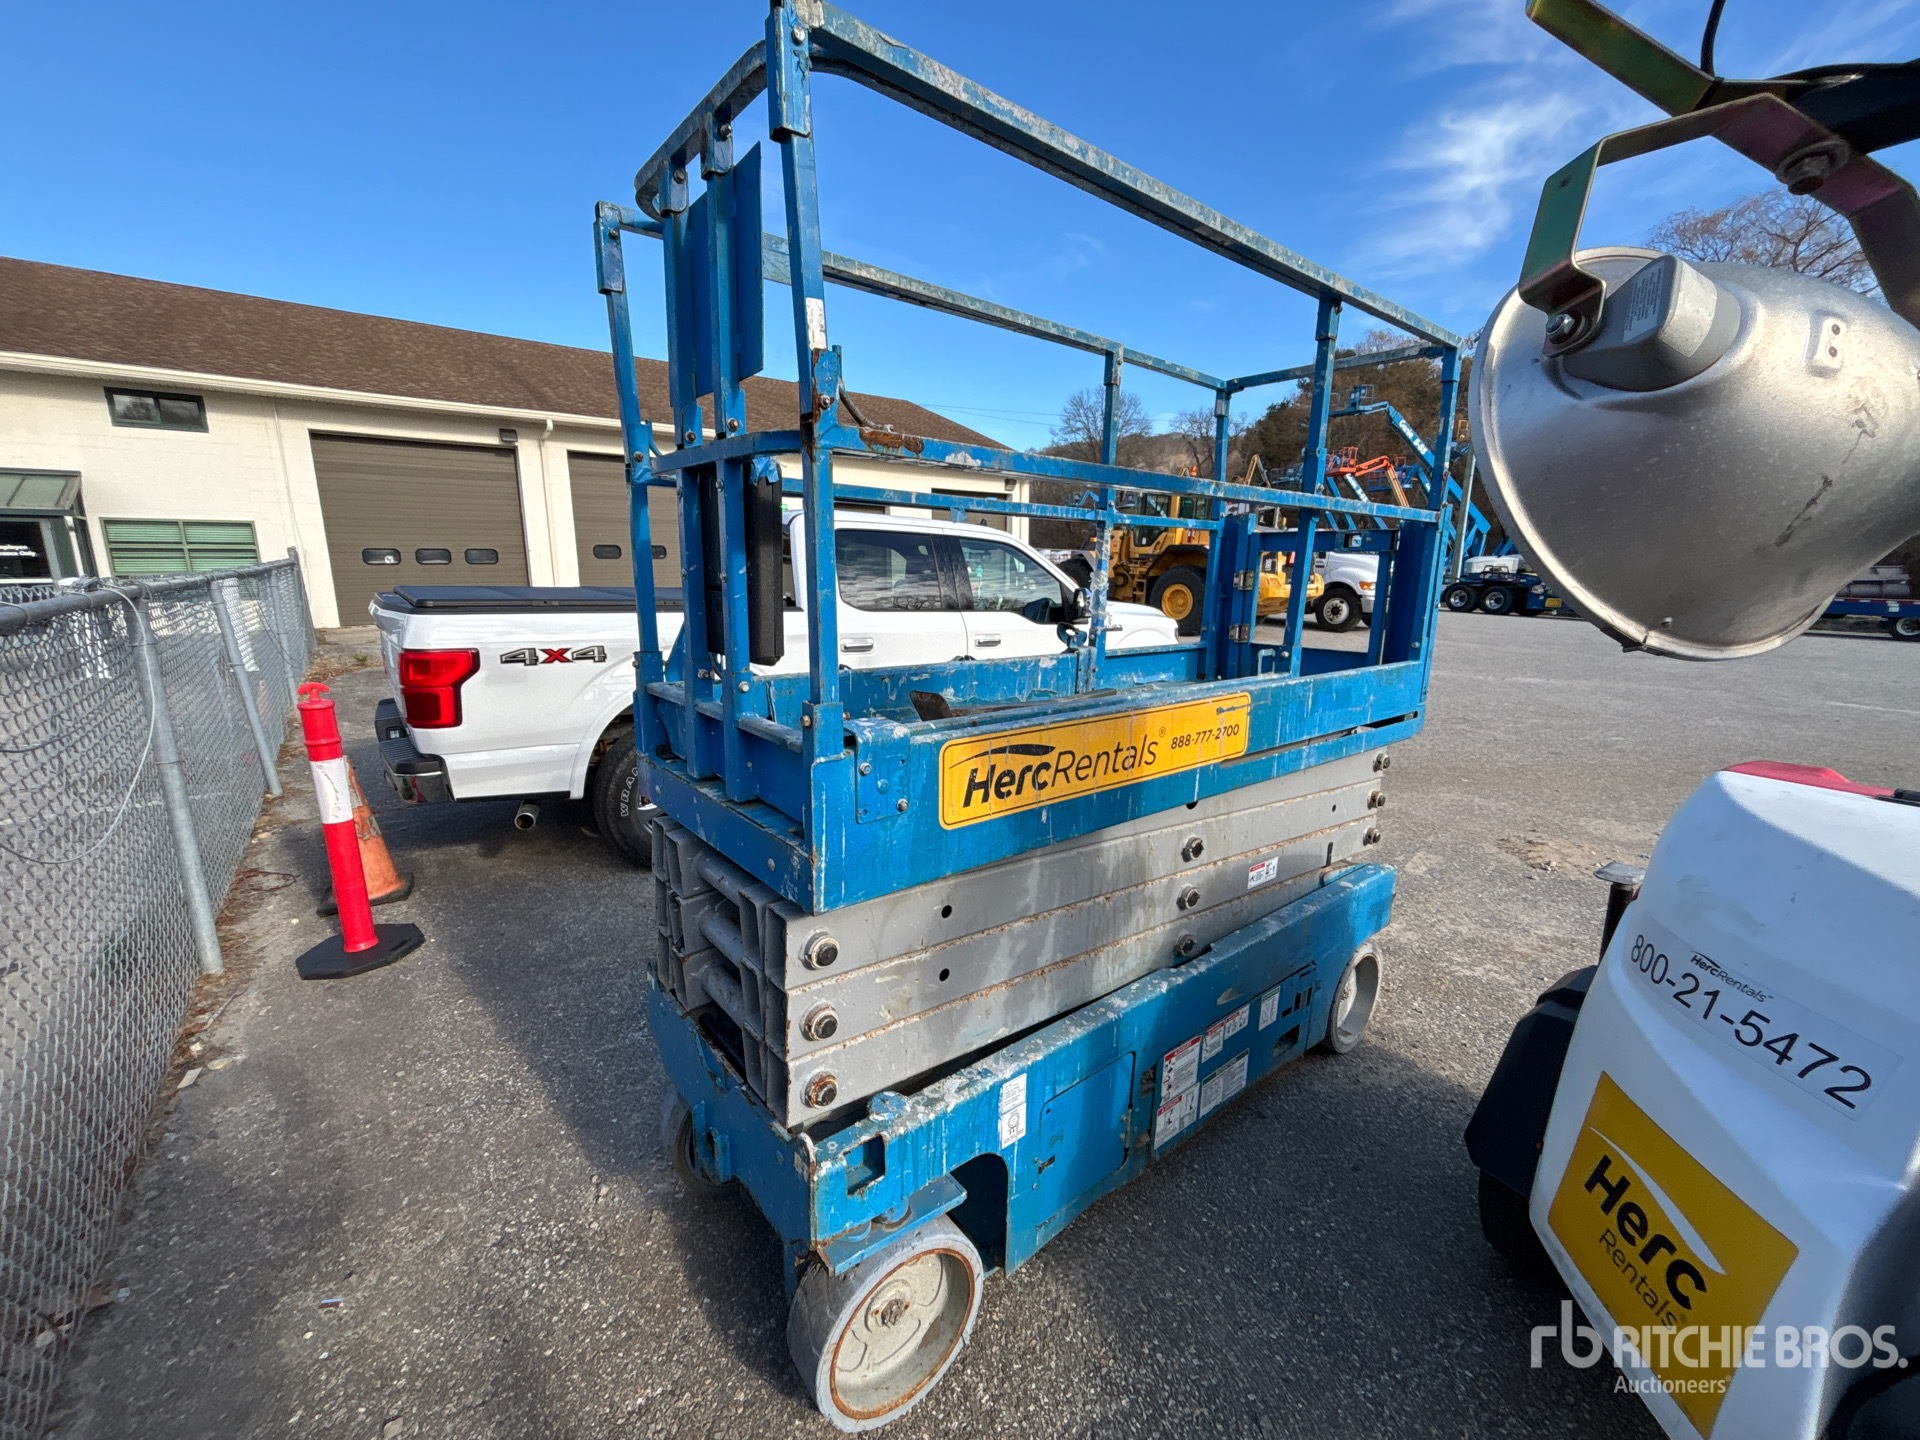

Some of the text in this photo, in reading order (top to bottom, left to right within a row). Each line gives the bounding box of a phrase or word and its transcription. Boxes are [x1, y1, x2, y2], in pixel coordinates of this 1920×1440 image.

[1399, 419, 1414, 440] Genie
[962, 724, 1240, 808] HercRentals 888-777-2700
[1631, 934, 1872, 1109] 800-21-5472
[1584, 1154, 1707, 1311] Herc
[1598, 1228, 1679, 1331] Rentals
